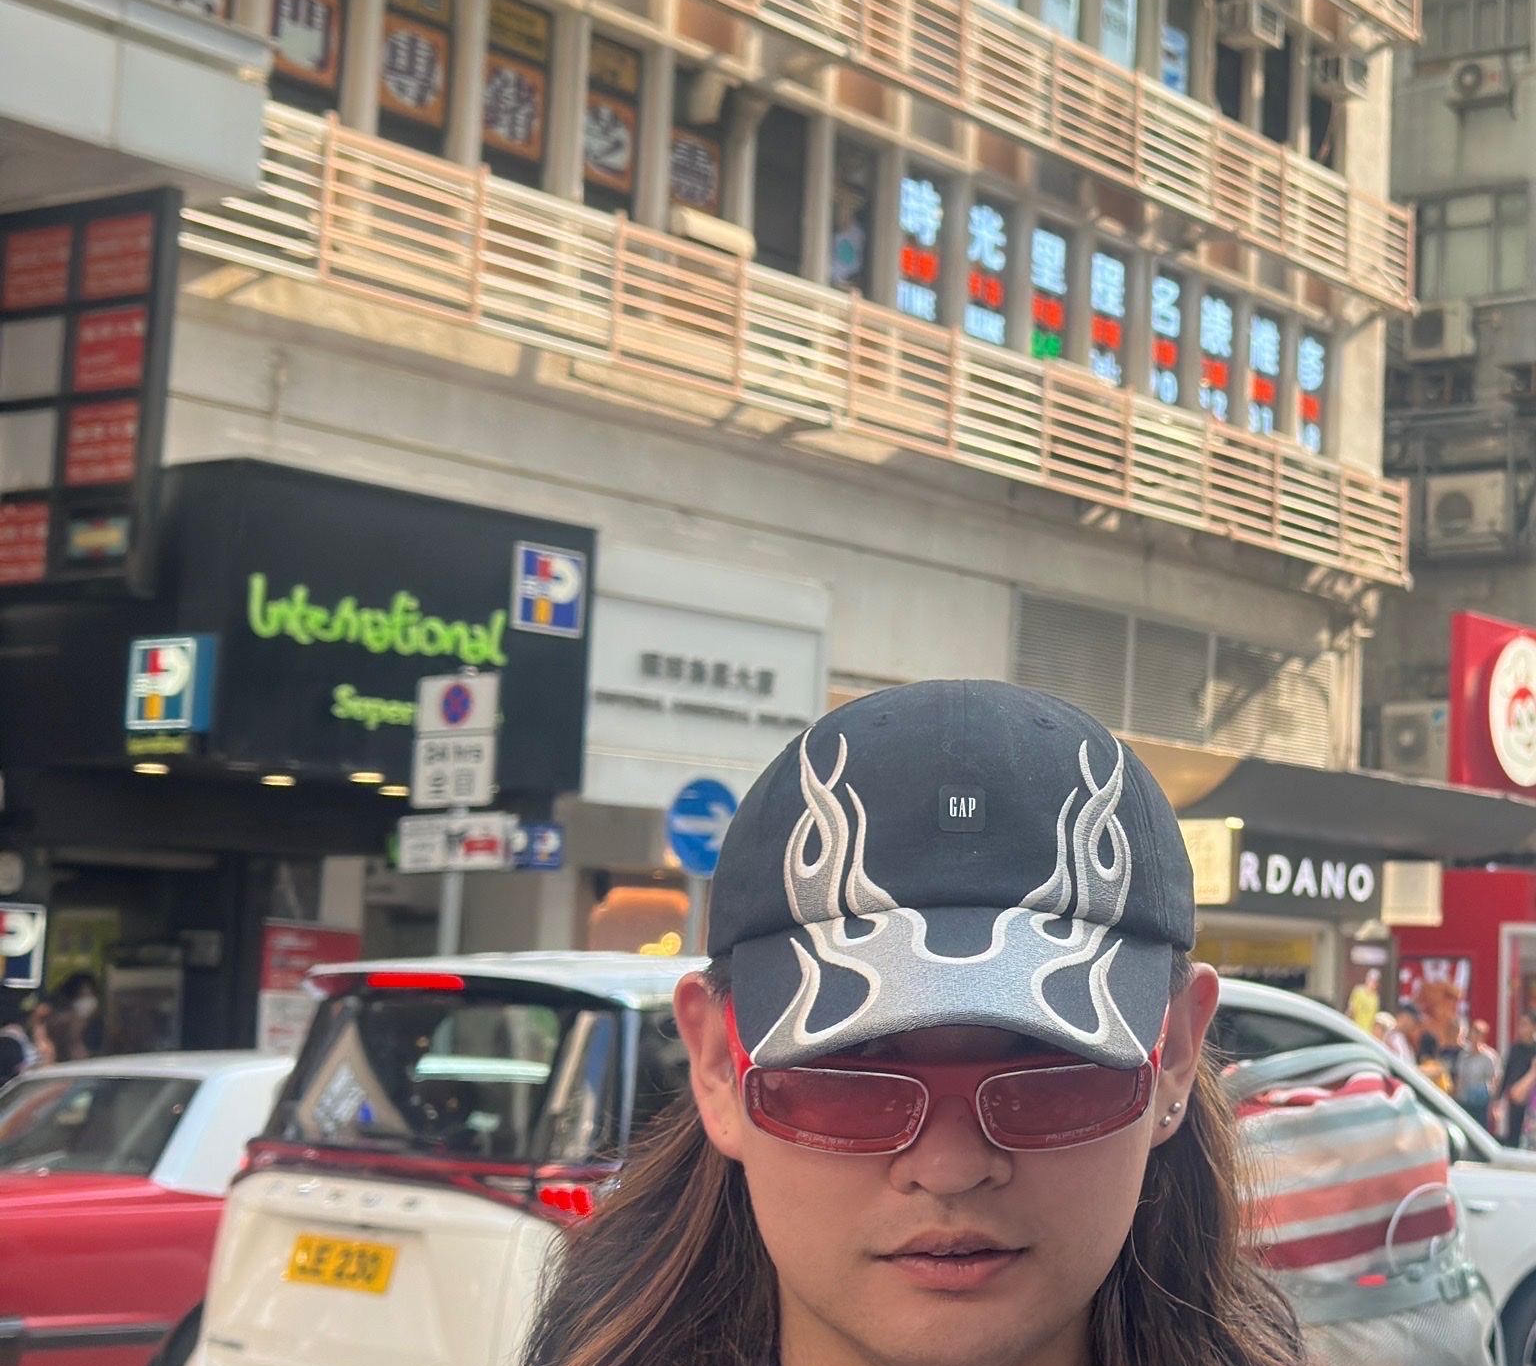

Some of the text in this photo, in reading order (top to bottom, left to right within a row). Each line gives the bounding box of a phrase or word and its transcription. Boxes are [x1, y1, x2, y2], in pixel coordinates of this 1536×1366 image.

[249, 572, 508, 667] International
[949, 796, 976, 818] GAP
[1239, 851, 1375, 903] RDANO
